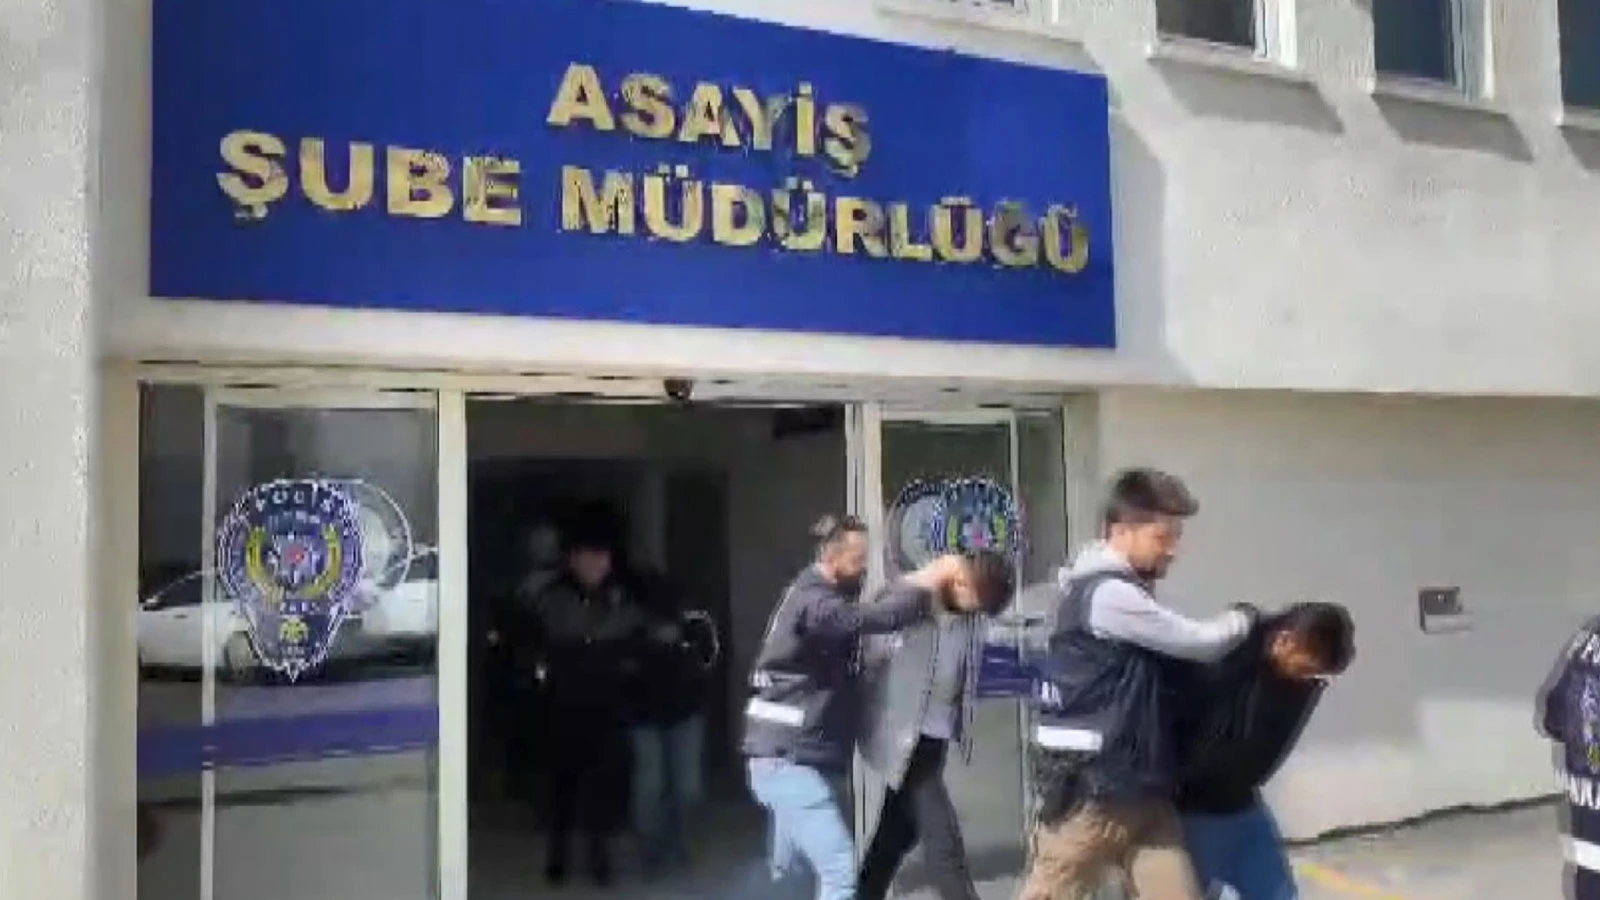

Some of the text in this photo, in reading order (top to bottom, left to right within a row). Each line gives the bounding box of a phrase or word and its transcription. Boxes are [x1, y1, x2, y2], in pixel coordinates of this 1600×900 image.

[547, 62, 871, 178] ASAYİŞ
[216, 129, 1090, 275] ŞUBE MÜDÜRLÜĞÜ
